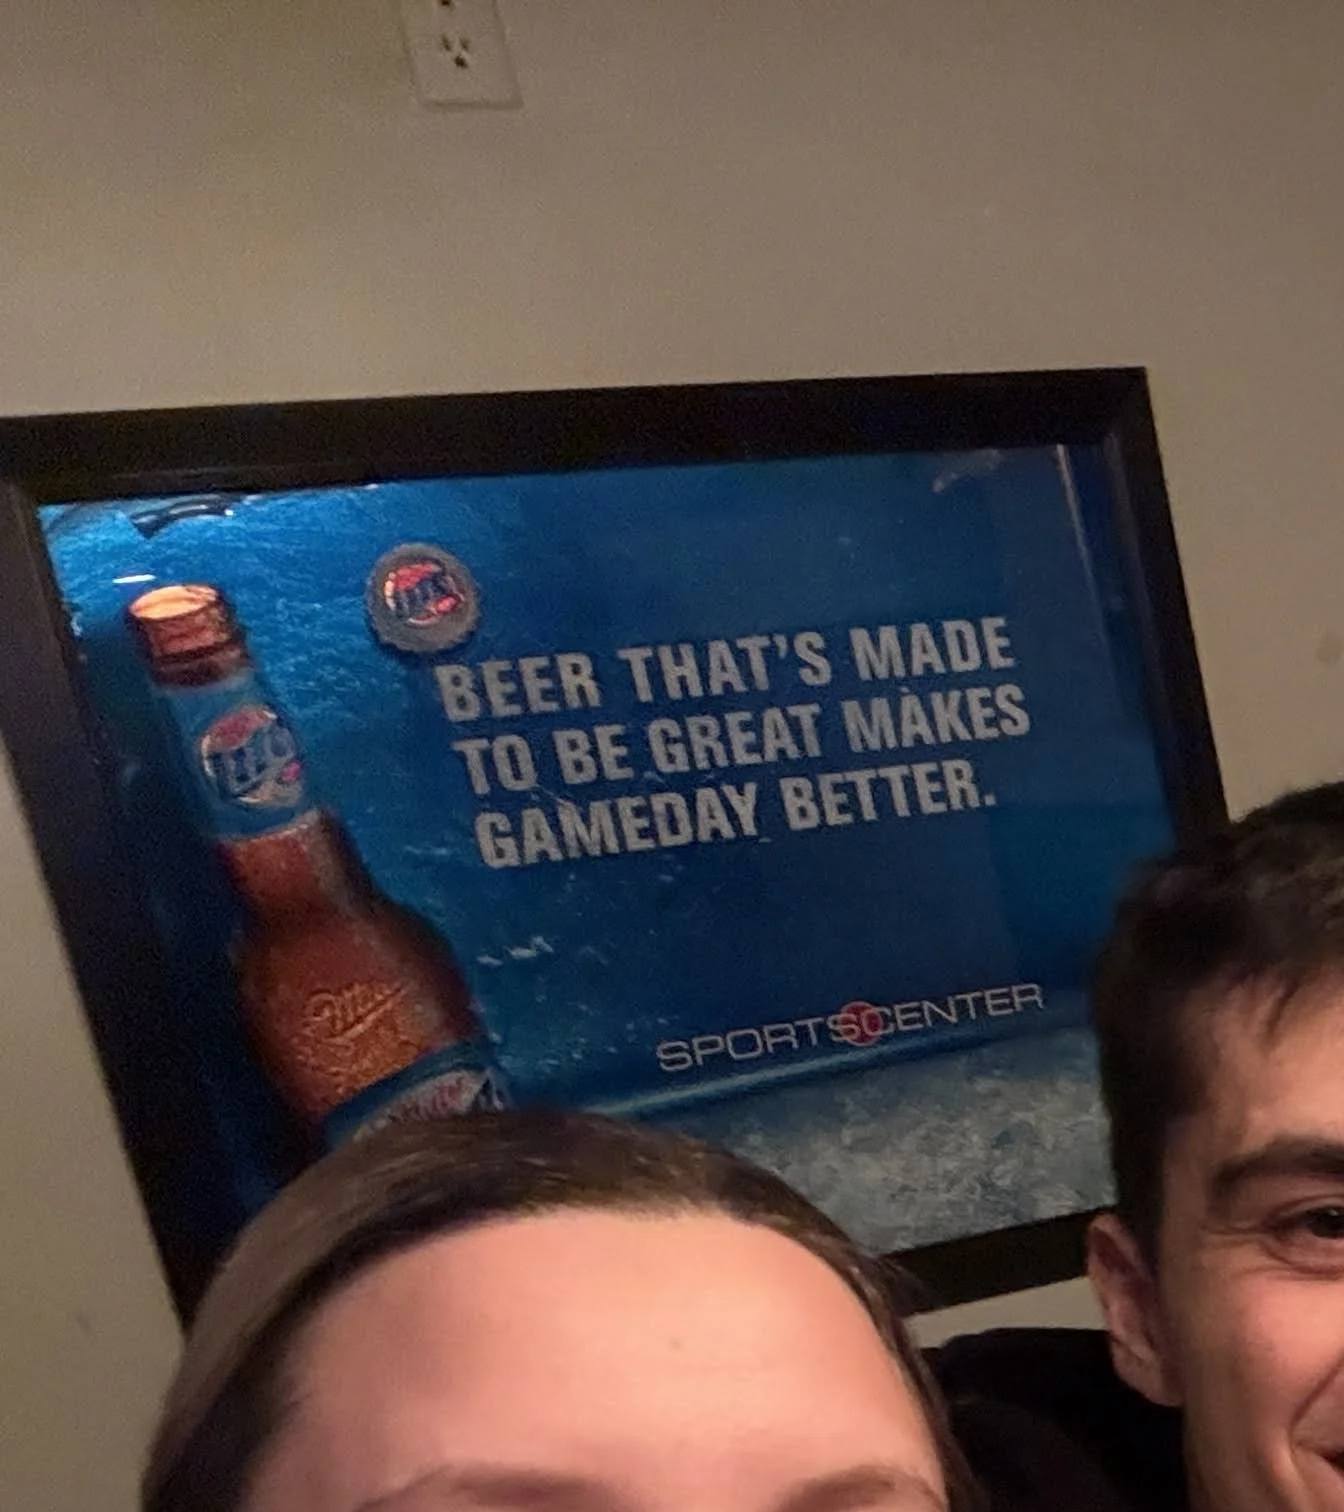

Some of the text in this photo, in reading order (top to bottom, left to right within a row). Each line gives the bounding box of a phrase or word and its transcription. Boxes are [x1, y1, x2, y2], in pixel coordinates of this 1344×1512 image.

[436, 617, 1014, 721] BEER THAT'S MADE
[454, 685, 1030, 794] TO BE GREAT MAKES
[475, 759, 996, 869] GAMEDAY BETTER.
[657, 983, 1043, 1071] SPORTSCENTER
